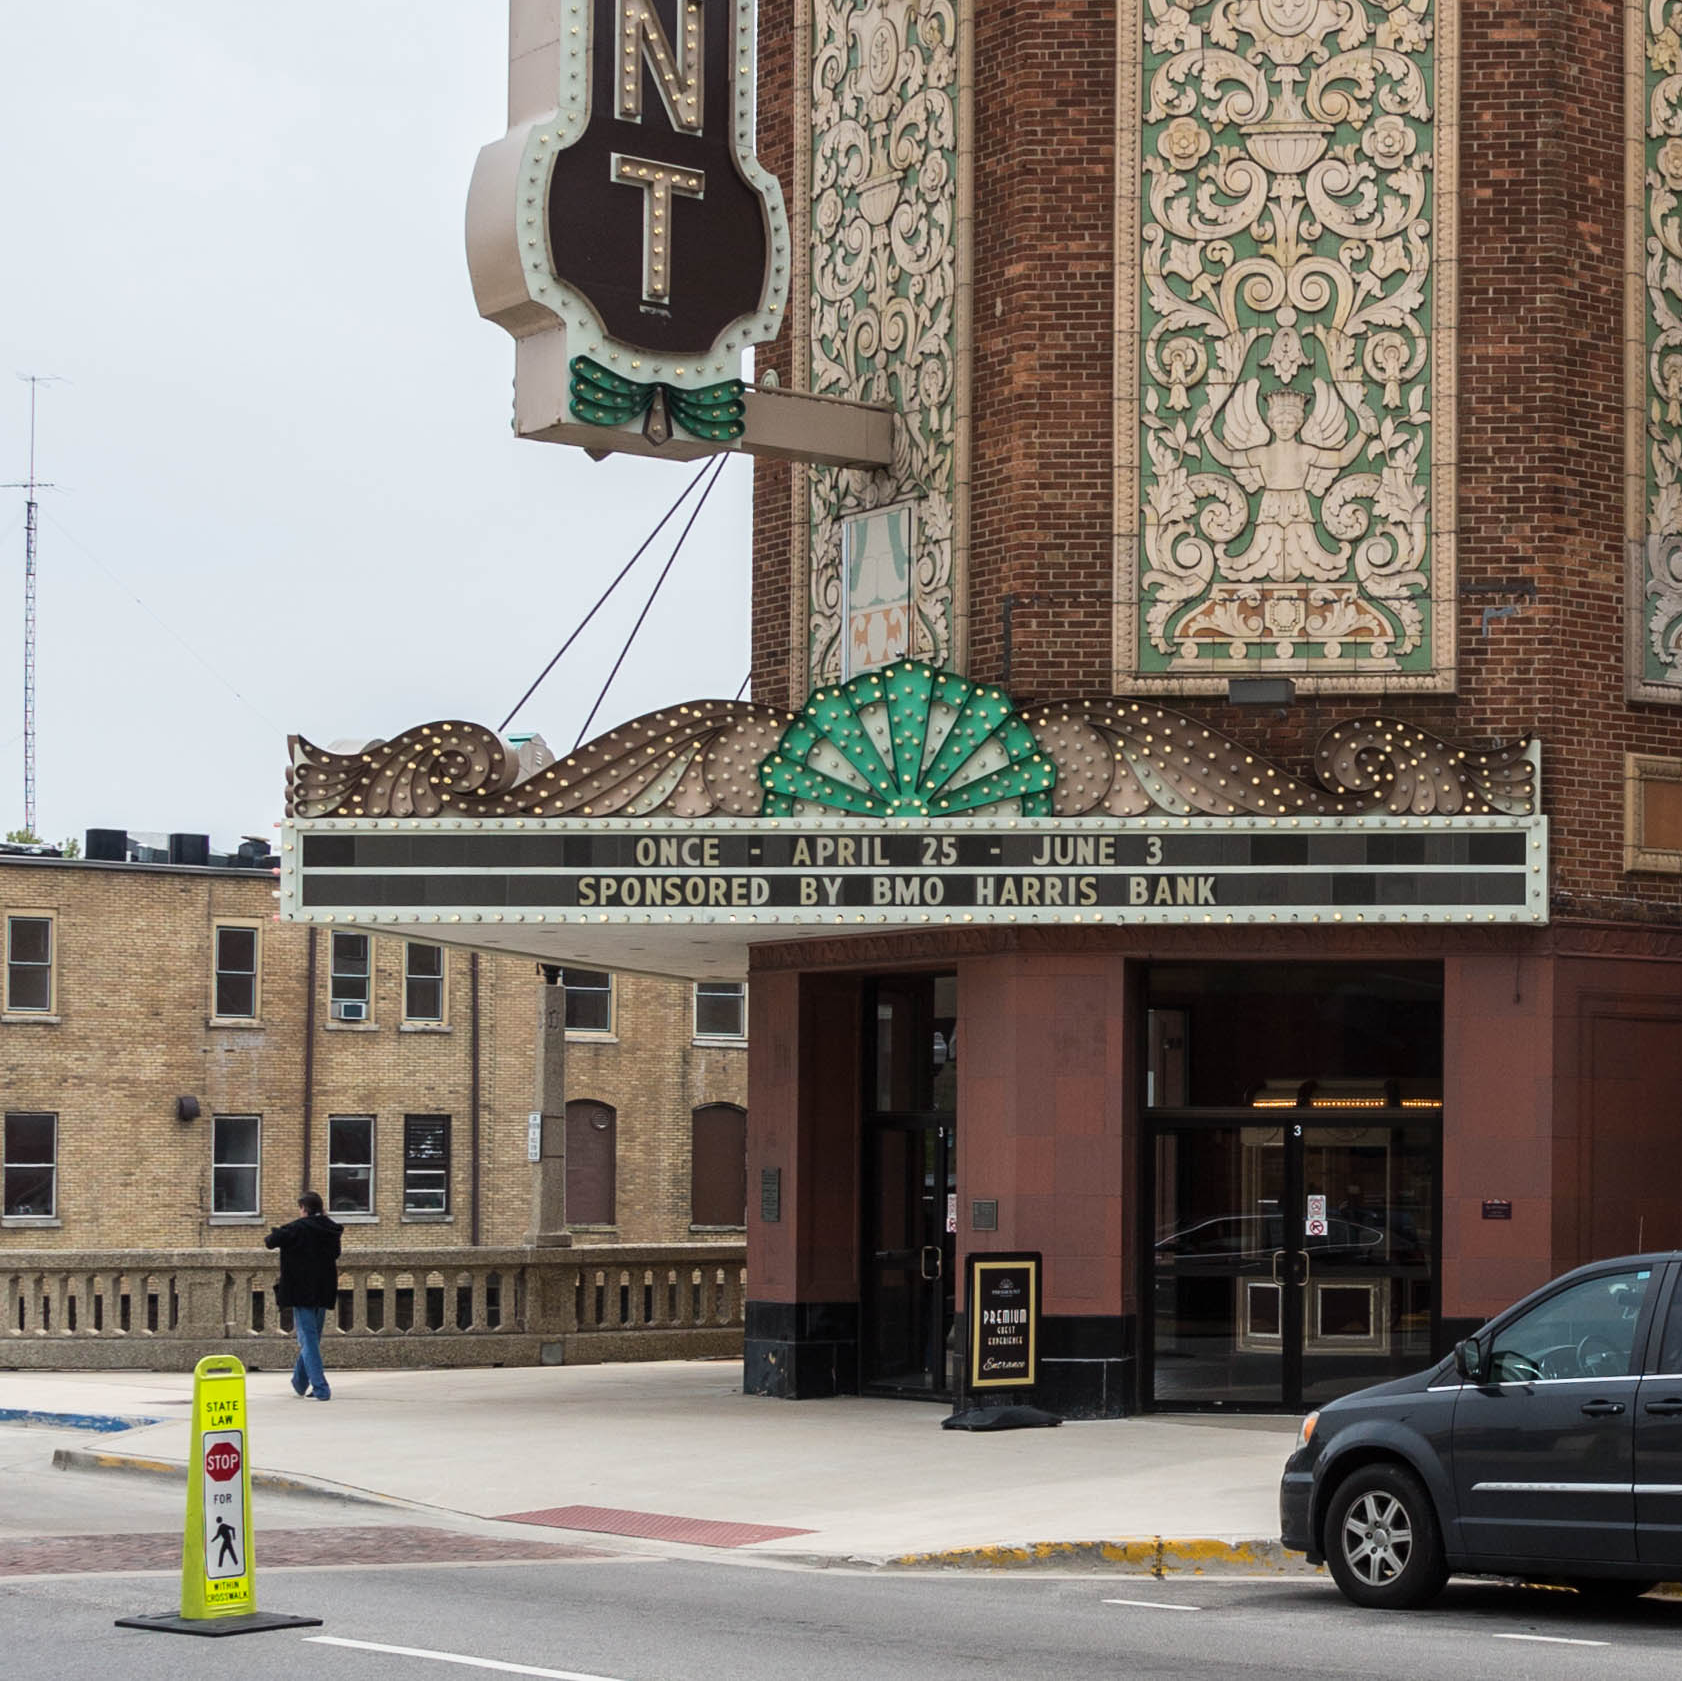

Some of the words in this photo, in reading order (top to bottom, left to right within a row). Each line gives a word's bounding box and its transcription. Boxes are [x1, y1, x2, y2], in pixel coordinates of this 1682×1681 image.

[637, 837, 720, 867] ONCE
[750, 847, 762, 855] -
[793, 837, 890, 866] APRIL
[921, 836, 958, 866] 25
[1033, 836, 1116, 866] JUNE
[1146, 836, 1163, 865] 3
[579, 876, 771, 906] SPONSORED
[801, 877, 844, 905] BY
[873, 876, 944, 905] BMO
[977, 876, 1098, 906] HARRIS
[1130, 876, 1216, 905] BANK
[1293, 1124, 1302, 1137] 3
[983, 1309, 1027, 1325] PREMIUM
[983, 1357, 1026, 1371] Entrance
[206, 1400, 239, 1413] STATE
[211, 1415, 233, 1427] LAW
[207, 1455, 239, 1471] STOP
[213, 1493, 232, 1505] FOR
[213, 1581, 240, 1592] WITHIN
[207, 1591, 249, 1604] CROSSWALK
